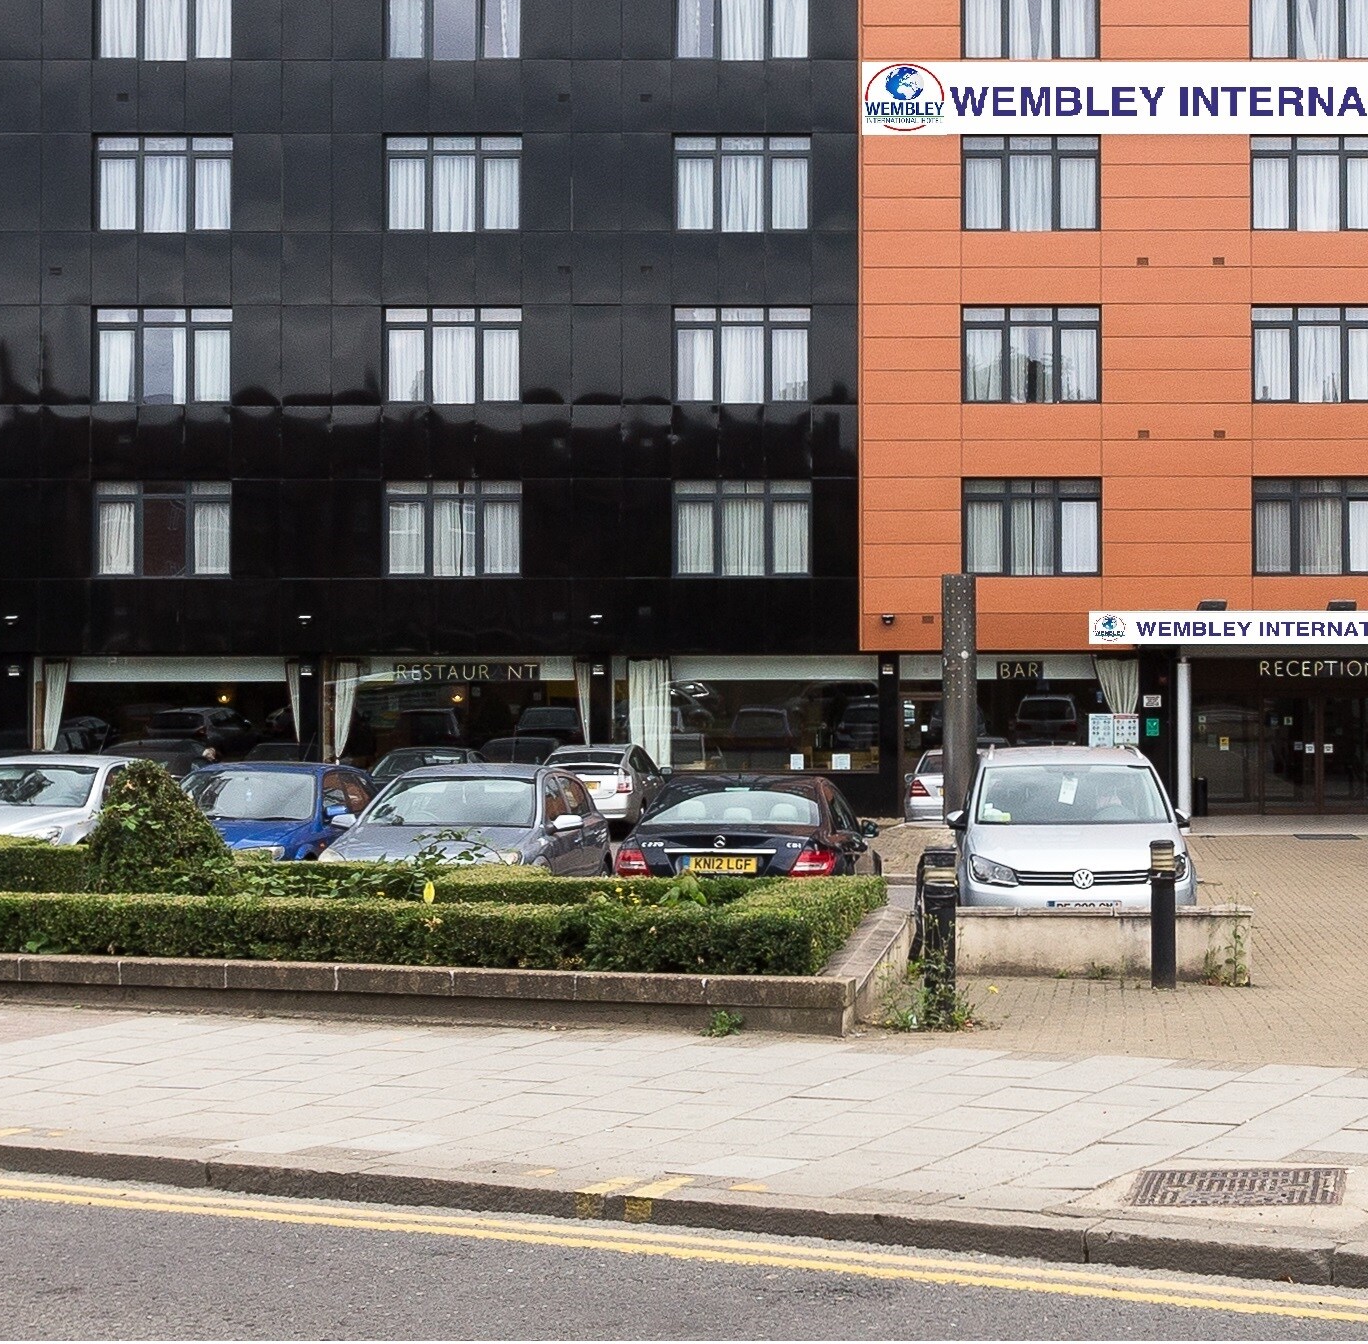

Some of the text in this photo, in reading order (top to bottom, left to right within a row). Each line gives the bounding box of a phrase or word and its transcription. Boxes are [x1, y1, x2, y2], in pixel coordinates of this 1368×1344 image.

[865, 102, 944, 115] WEMBLEY
[950, 86, 1165, 116] WEMBLEY
[1135, 621, 1252, 636] WEMBLEY
[396, 663, 538, 681] RESTAURNT
[1000, 662, 1039, 679] BAR
[694, 858, 752, 870] KN12 LGF
